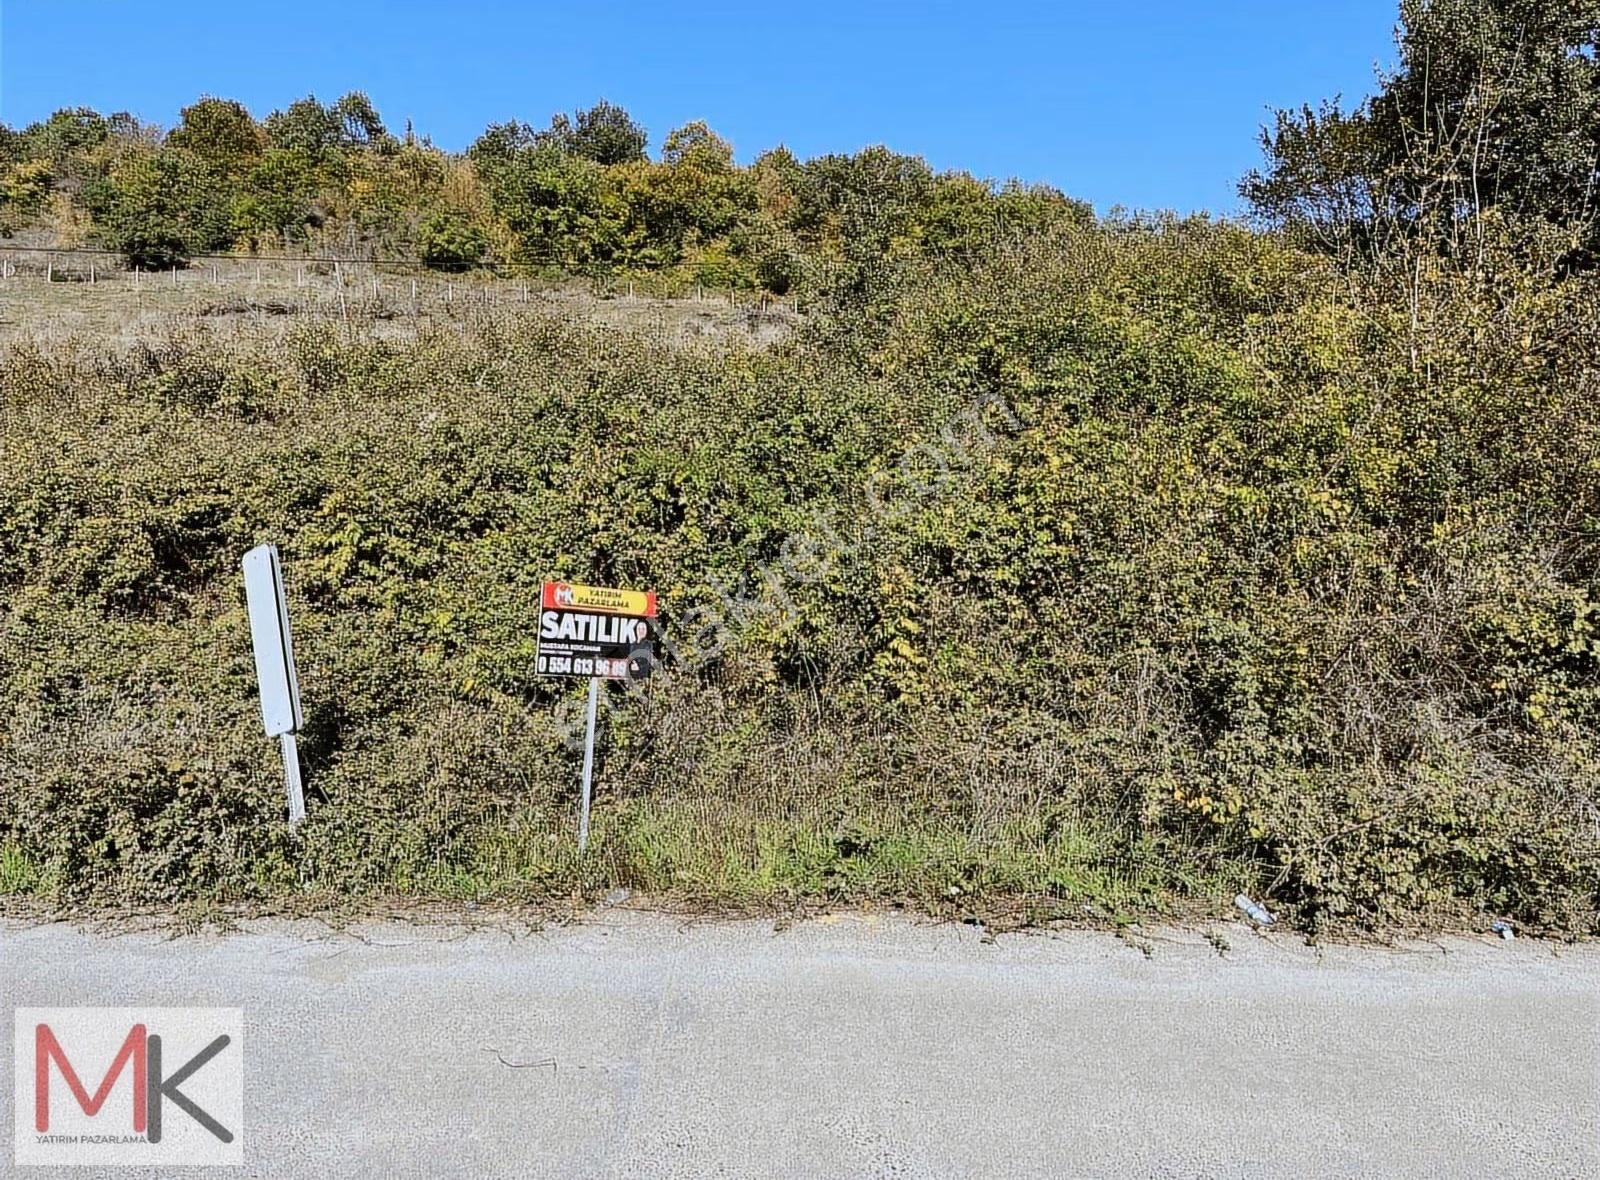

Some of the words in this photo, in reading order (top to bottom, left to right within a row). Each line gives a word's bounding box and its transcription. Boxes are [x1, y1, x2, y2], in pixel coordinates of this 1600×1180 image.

[589, 587, 622, 599] YATIRIM
[577, 596, 630, 609] PAZARLAMA
[540, 610, 638, 644] SATILIK
[538, 656, 547, 673] 0
[548, 657, 571, 674] 554
[573, 658, 593, 675] 613
